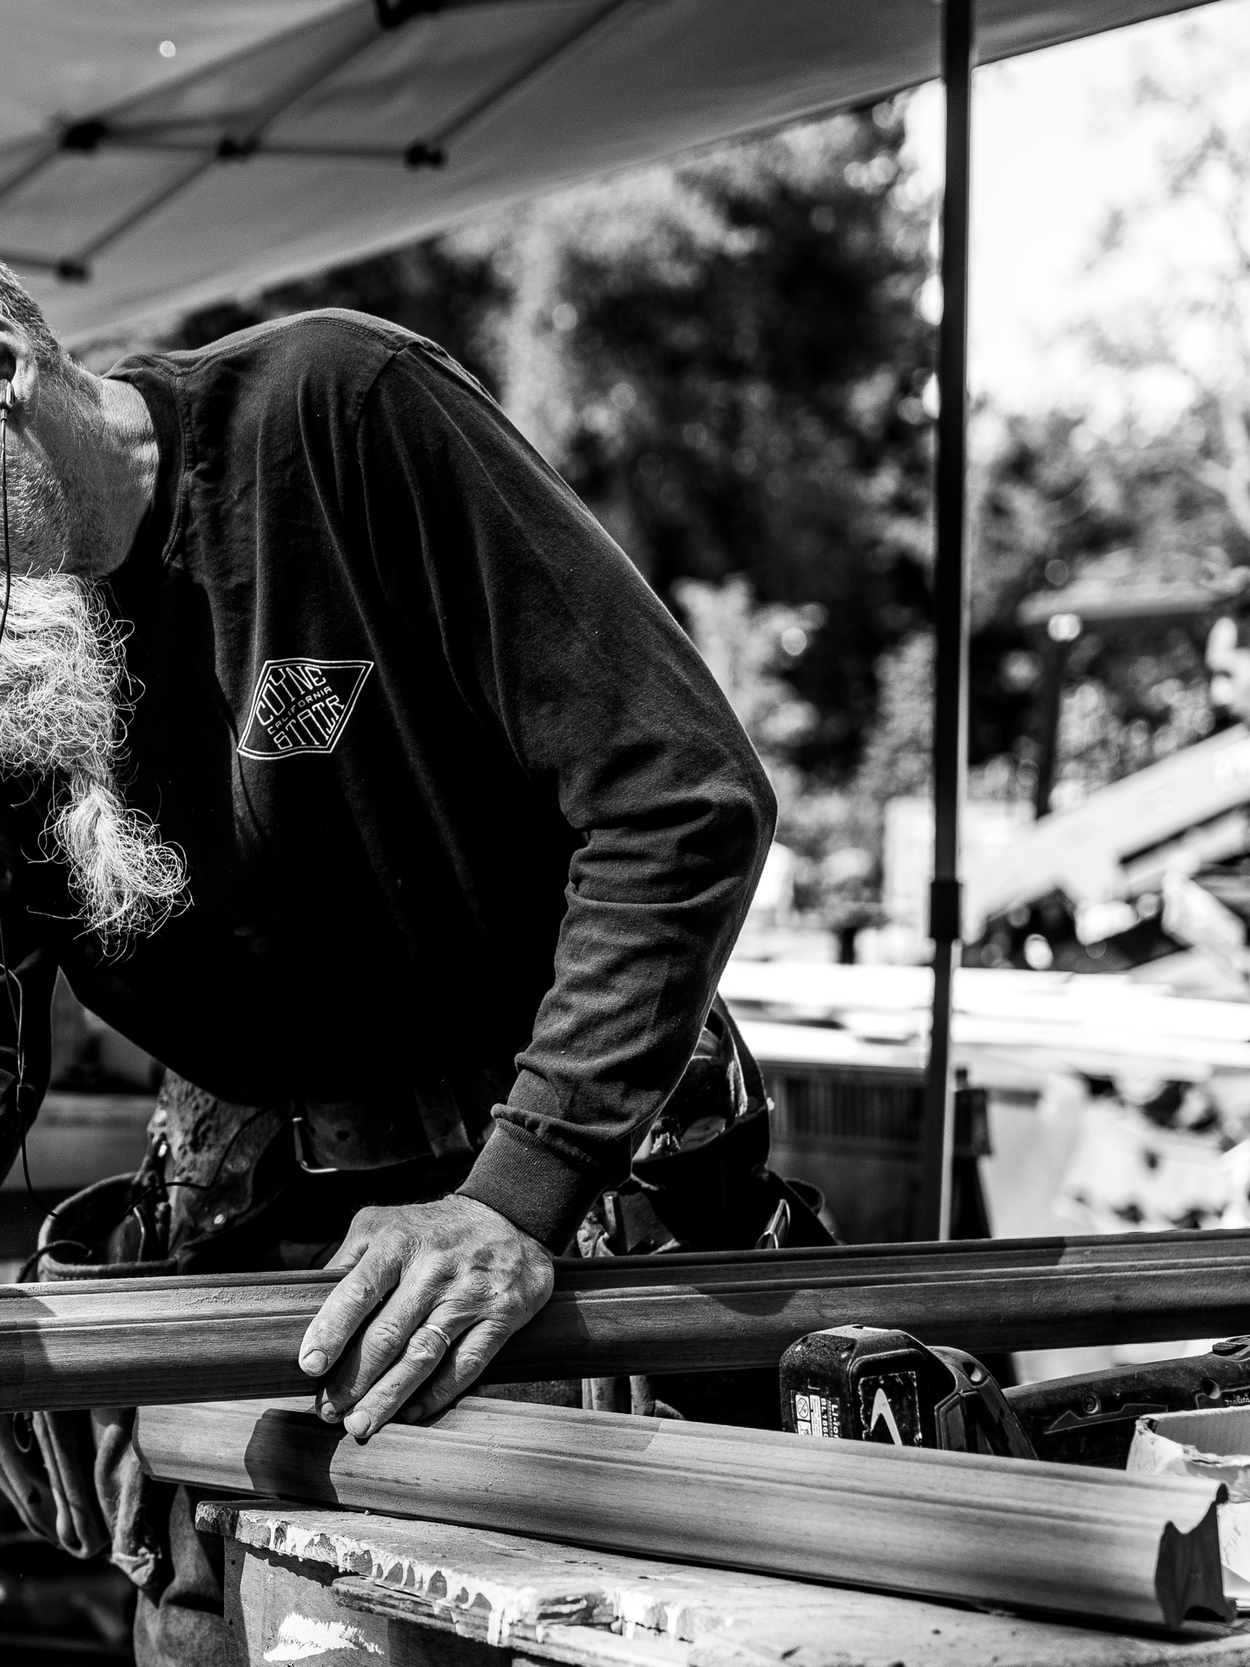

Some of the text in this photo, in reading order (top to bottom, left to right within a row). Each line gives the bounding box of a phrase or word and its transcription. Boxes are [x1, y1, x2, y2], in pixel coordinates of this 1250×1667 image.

[255, 666, 326, 726] COYNE
[267, 686, 332, 735] CALIFORNIA
[273, 695, 345, 750] STAIR
